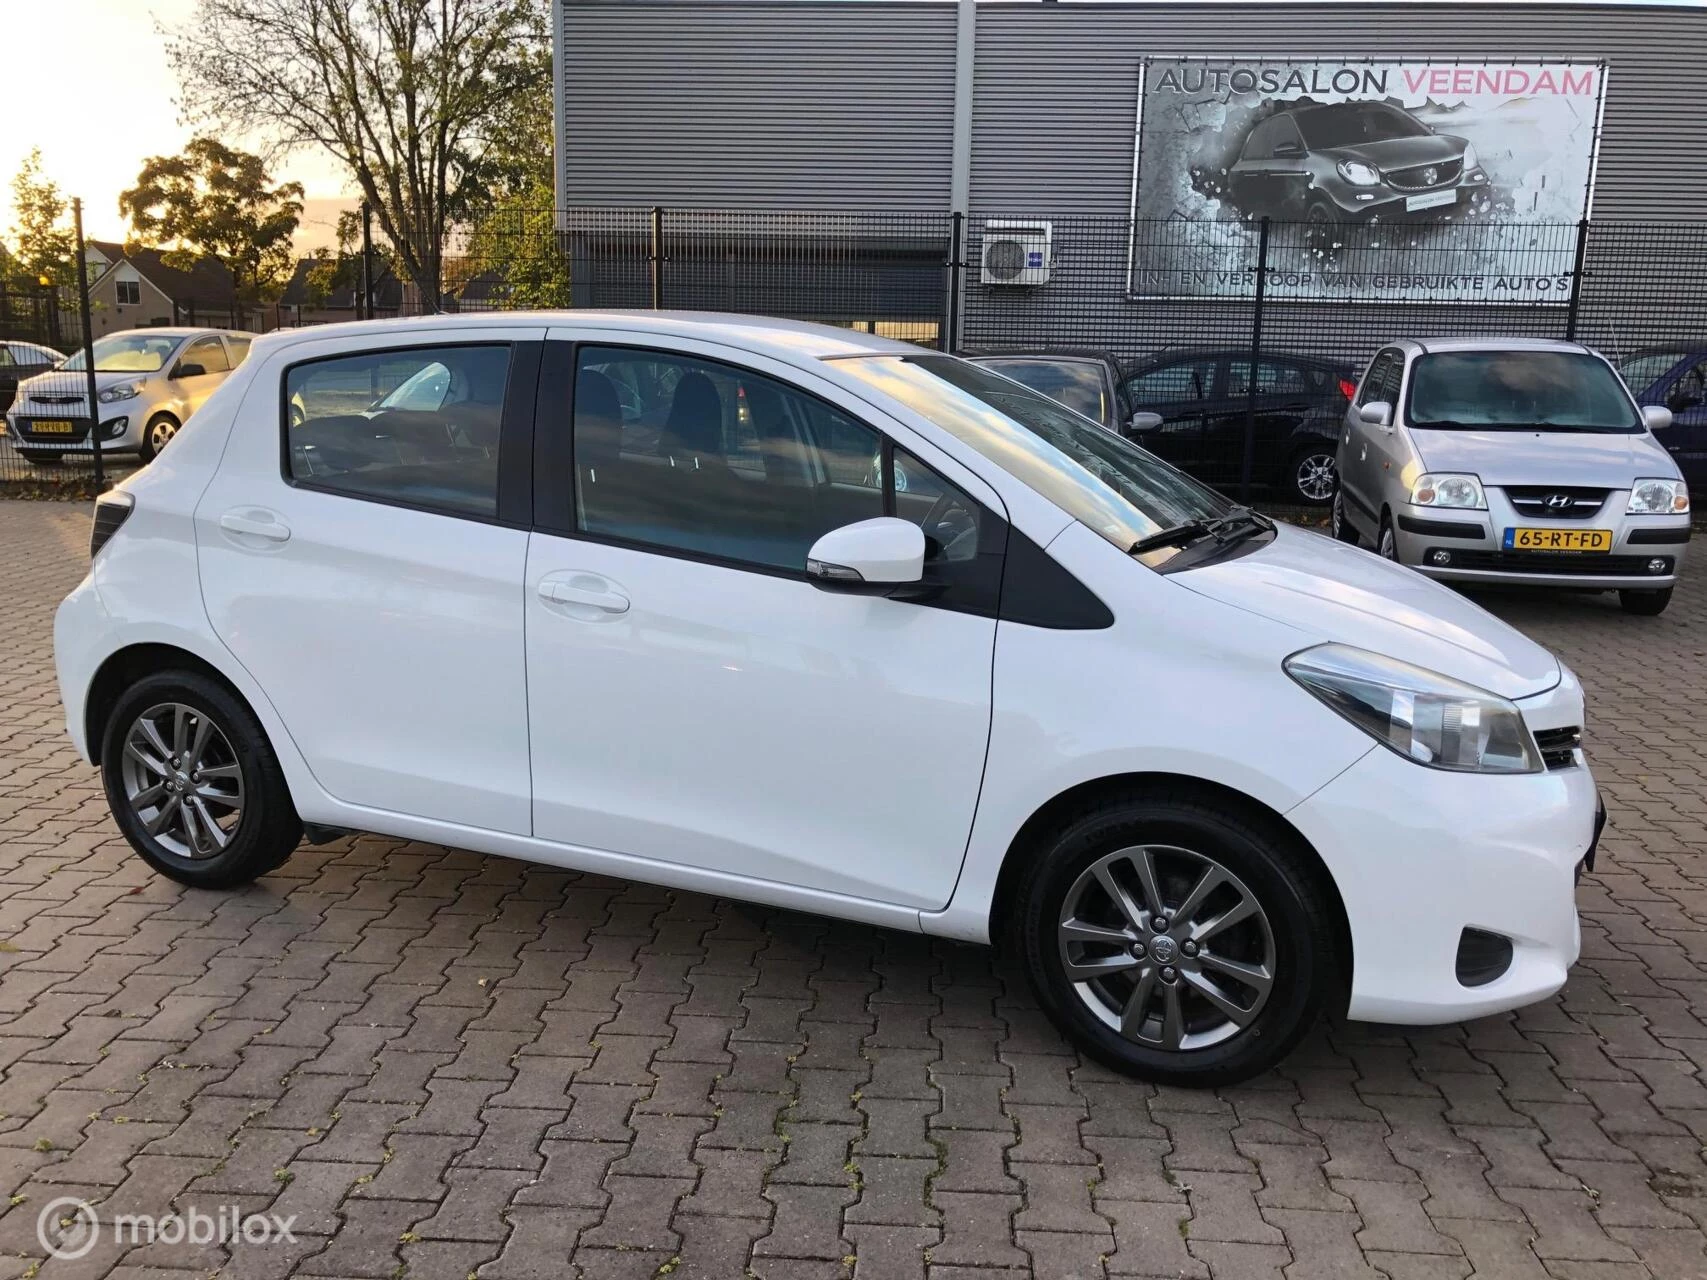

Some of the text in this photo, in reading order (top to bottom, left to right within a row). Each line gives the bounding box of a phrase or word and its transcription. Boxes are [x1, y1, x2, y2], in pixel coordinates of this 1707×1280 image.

[1152, 68, 1594, 96] AUTOSALON VEENDAM
[1181, 271, 1205, 286] EN
[1320, 273, 1361, 289] VAN
[1372, 274, 1484, 290] GEBRUIKTE
[1494, 274, 1569, 291] AUTO'S
[1519, 531, 1603, 547] 65-RT-FD
